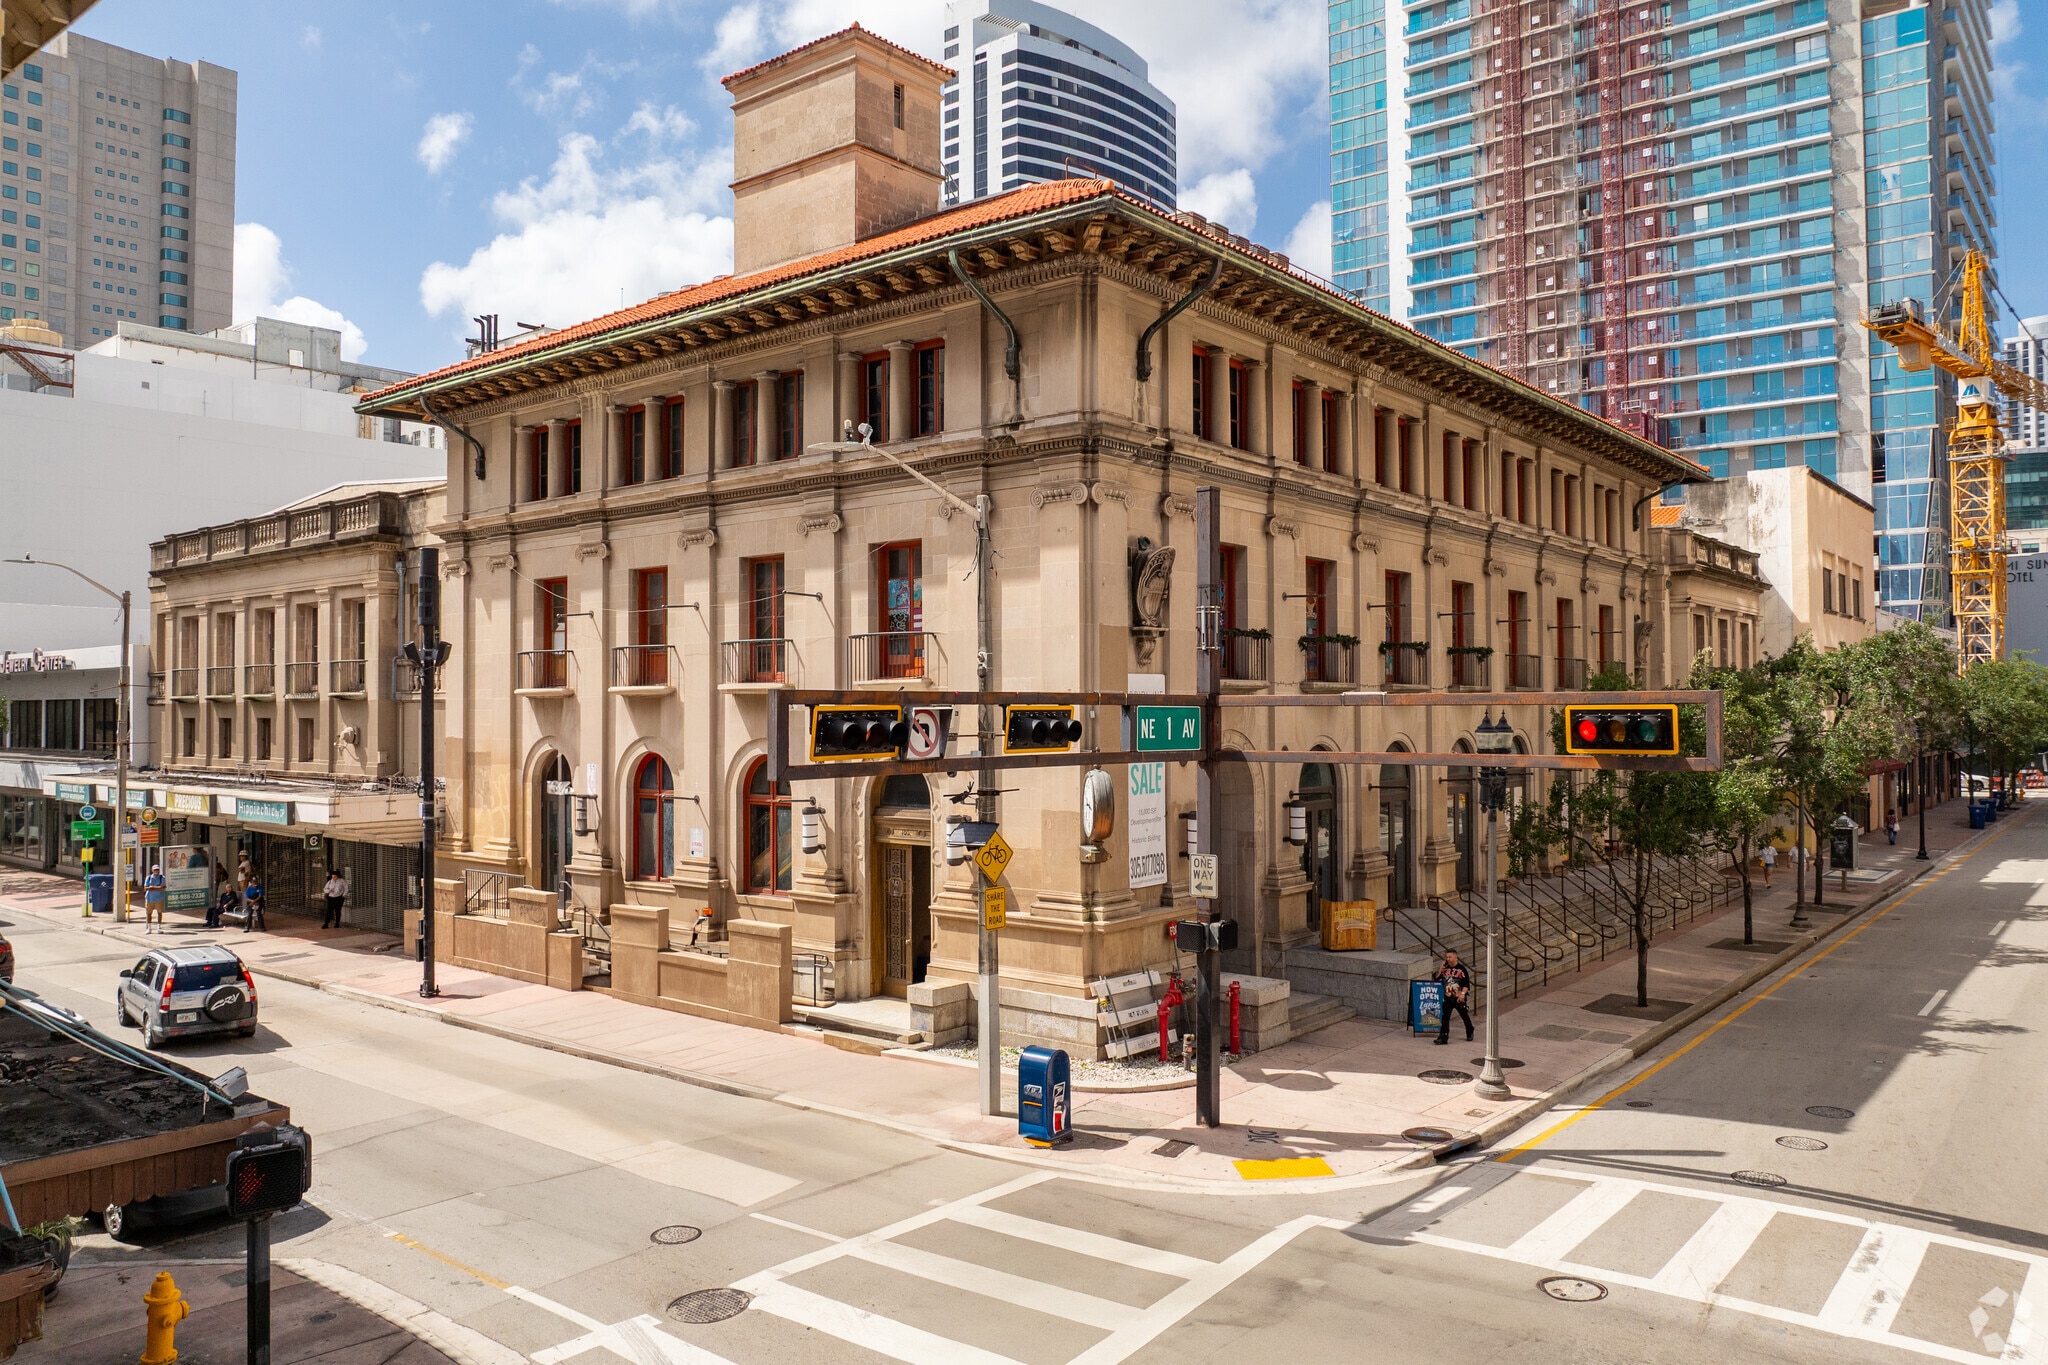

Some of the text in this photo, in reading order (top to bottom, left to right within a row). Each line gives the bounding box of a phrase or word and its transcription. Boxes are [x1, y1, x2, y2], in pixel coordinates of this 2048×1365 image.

[33, 648, 66, 673] CENTER
[1141, 716, 1195, 741] NE 1 AV
[1130, 763, 1164, 796] SALE
[1194, 858, 1213, 869] ONE
[1193, 869, 1214, 880] WAY
[986, 891, 1004, 902] SHARE
[990, 904, 1000, 913] THE
[988, 915, 1003, 925] ROAD
[1420, 986, 1439, 994] NOW
[1419, 993, 1440, 1001] OPEN
